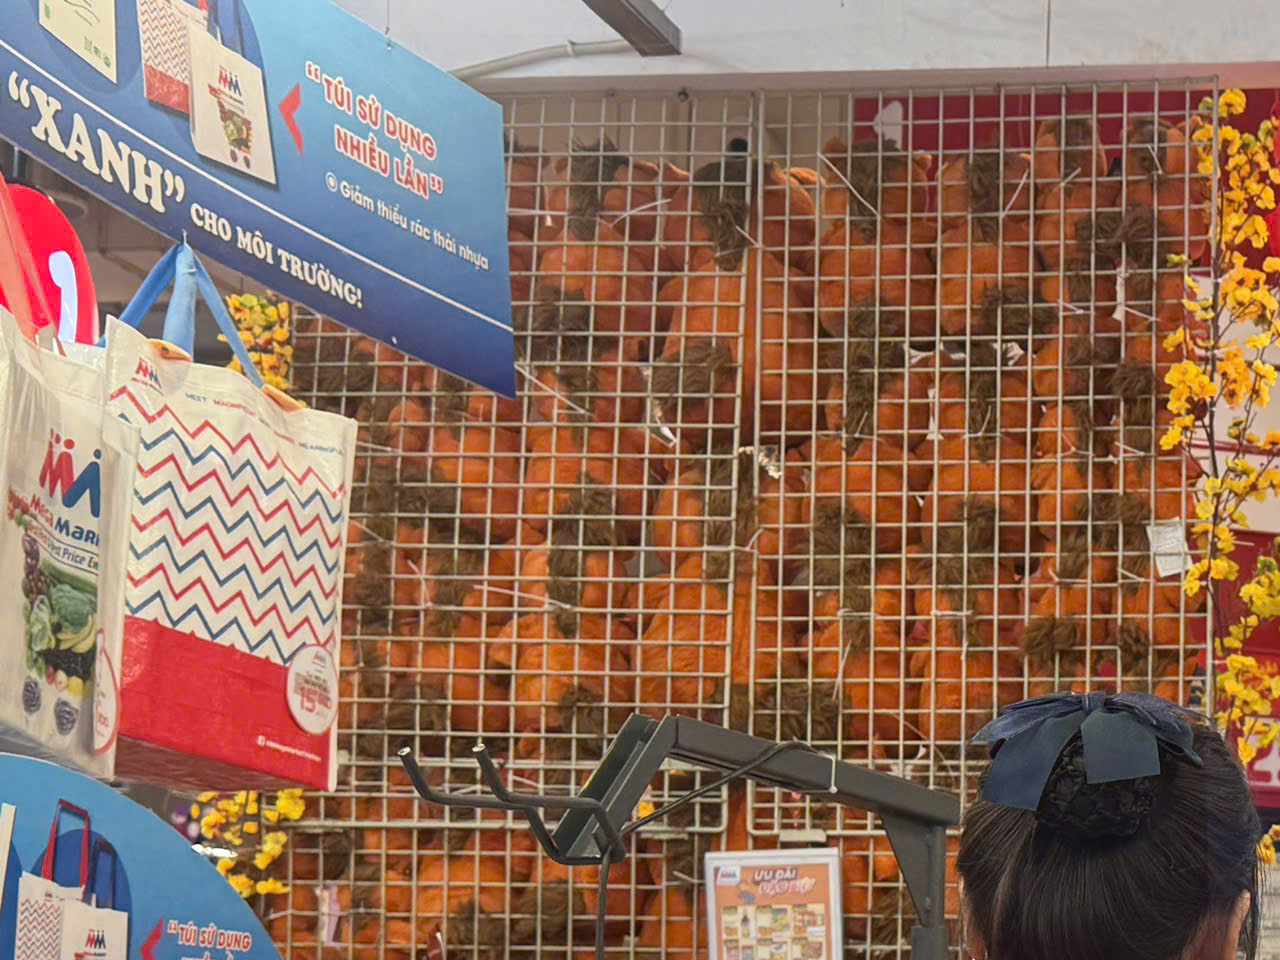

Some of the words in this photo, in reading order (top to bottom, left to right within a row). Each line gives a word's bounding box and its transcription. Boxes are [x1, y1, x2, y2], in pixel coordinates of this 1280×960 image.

[334, 123, 390, 177] NHIỀU
[356, 94, 381, 130] SỬ
[384, 109, 437, 160] DỤNG
[8, 71, 185, 213] “XANH”
[190, 203, 232, 242] CHO
[236, 226, 275, 265] MÔI
[277, 248, 364, 309] TRƯỜNG!
[340, 180, 375, 212] Giảm
[377, 198, 408, 230] thiểu
[410, 218, 431, 241] rác
[433, 231, 457, 255] thải
[459, 245, 489, 273] nhựa
